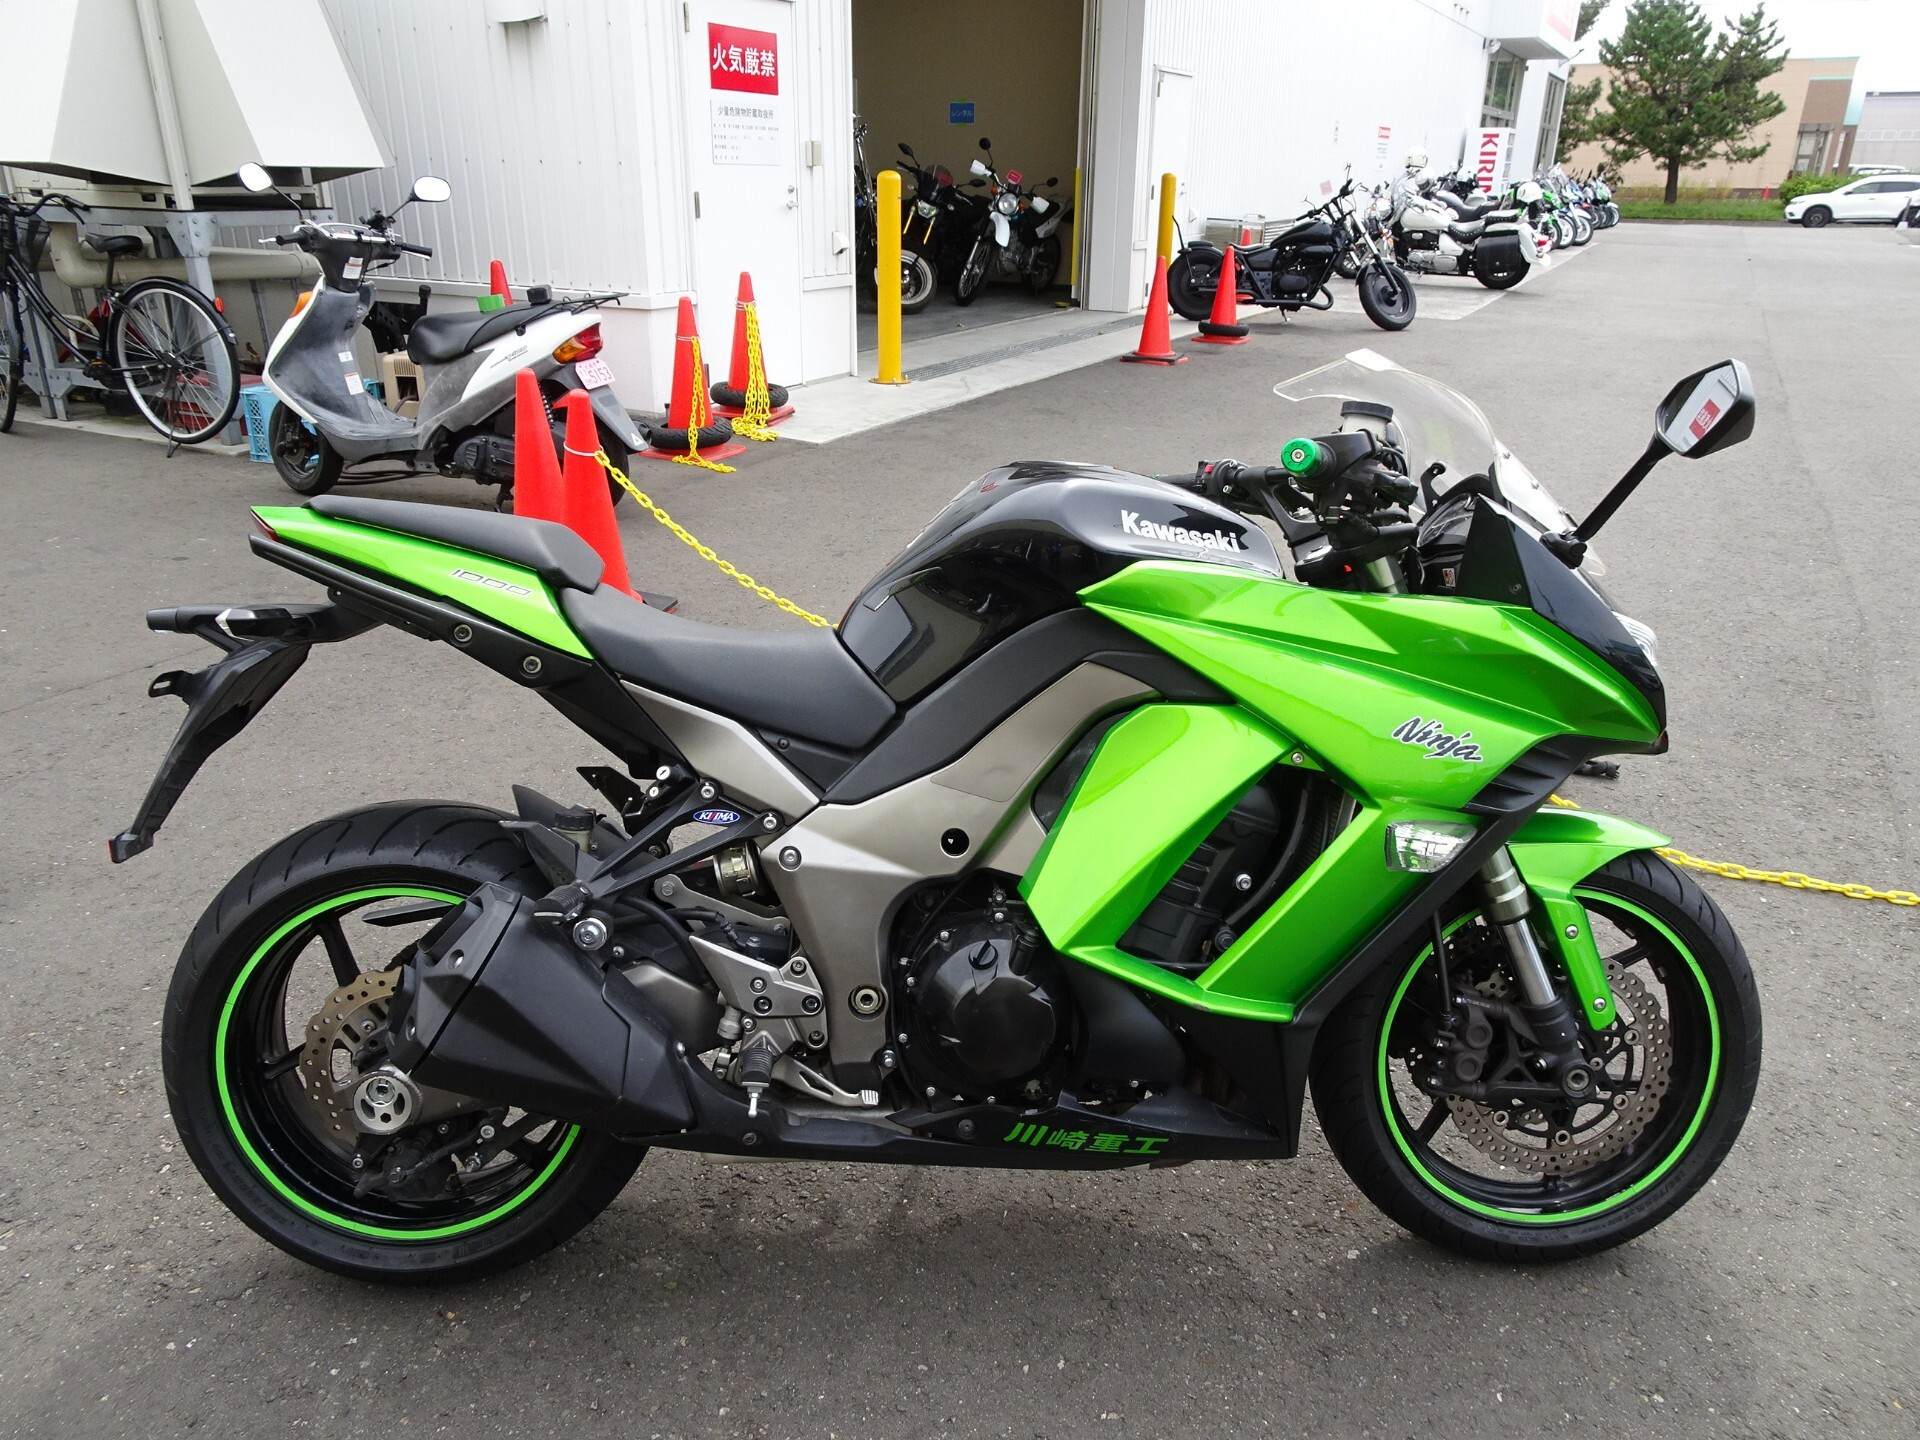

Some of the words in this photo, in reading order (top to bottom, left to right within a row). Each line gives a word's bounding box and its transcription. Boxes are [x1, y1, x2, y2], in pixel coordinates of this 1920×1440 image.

[712, 42, 775, 77] 火気厳禁
[1120, 509, 1240, 553] Kawasaki
[450, 568, 533, 597] 1000
[1392, 716, 1483, 762] Ninja
[1003, 1122, 1170, 1155] 川崎重工
